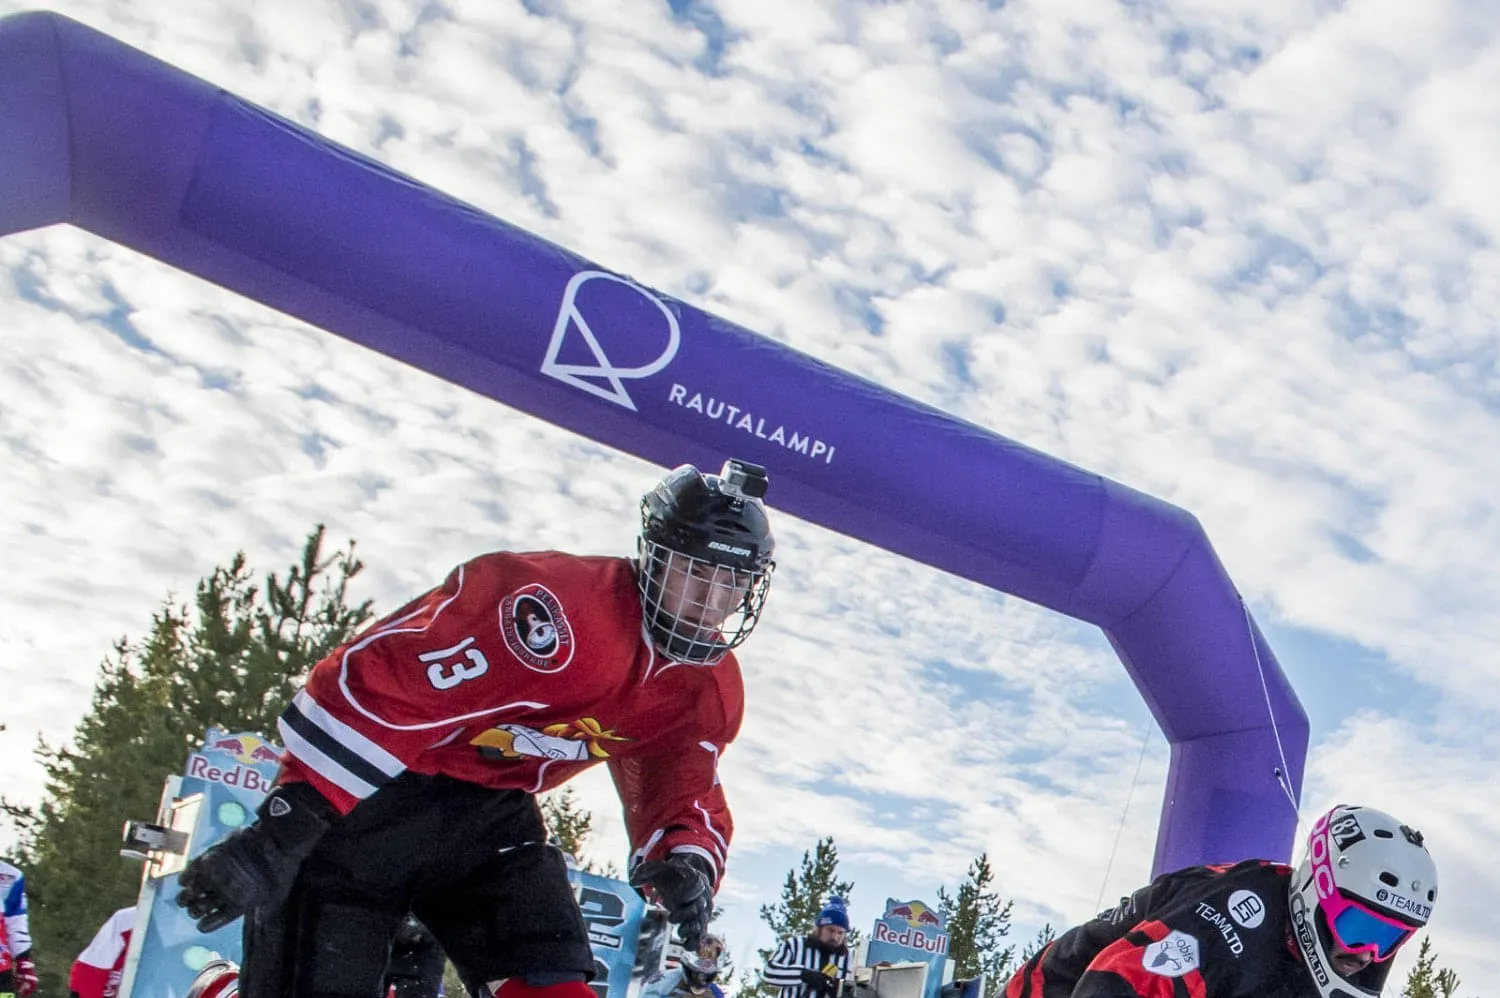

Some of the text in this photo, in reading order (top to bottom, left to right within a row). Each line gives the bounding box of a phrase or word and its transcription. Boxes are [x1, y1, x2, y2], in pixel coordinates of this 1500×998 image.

[668, 383, 836, 464] RAUTALAMPI
[417, 636, 489, 691] 13
[191, 756, 270, 794] Red Bu
[1331, 818, 1361, 847] 82
[1390, 893, 1433, 919] TEAMLTD
[875, 923, 947, 954] Red Bull
